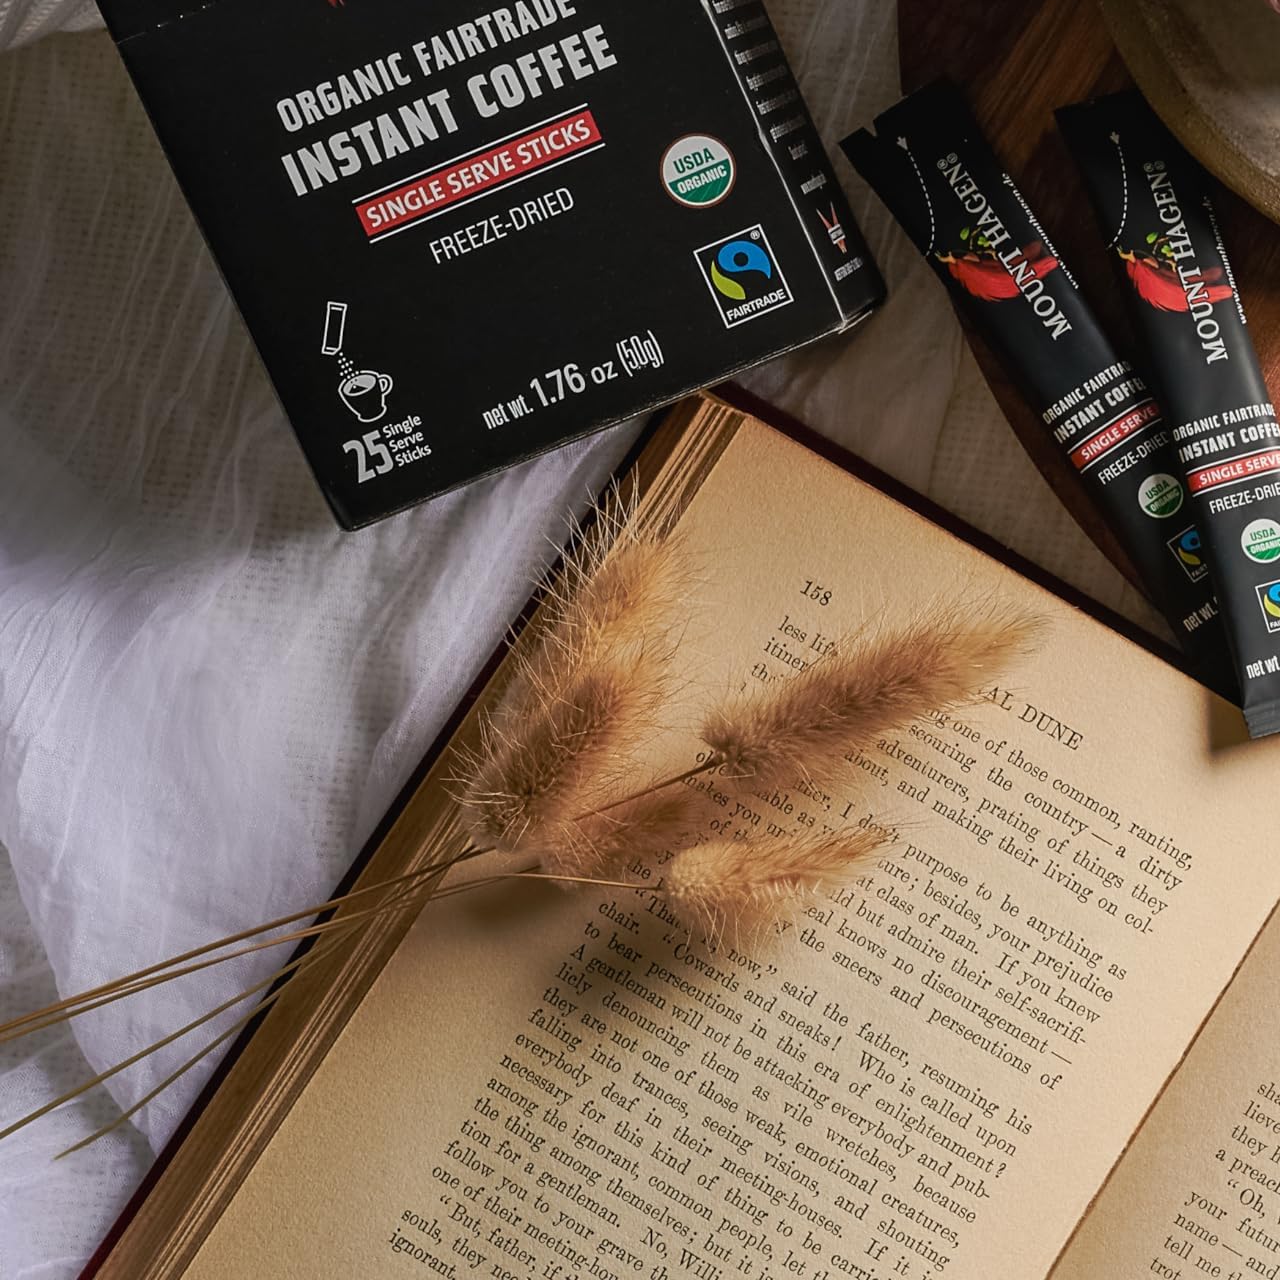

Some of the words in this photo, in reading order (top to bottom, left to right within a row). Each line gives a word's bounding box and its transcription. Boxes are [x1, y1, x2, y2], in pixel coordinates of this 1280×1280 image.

[276, 52, 412, 133] ORGANIC
[281, 88, 459, 197] INSTANT
[466, 24, 618, 118] COFFEE
[366, 180, 446, 228] SINGLE
[447, 151, 516, 194] SERVE
[520, 119, 591, 165] STICKS
[673, 147, 715, 174] USDA
[677, 165, 728, 195] ORGANIC
[429, 187, 575, 264] FREEZE-DRIED
[726, 288, 787, 321] FAIRTRADE
[998, 246, 1072, 341] MOUNT
[1177, 266, 1229, 365] MOUNT
[482, 402, 508, 430] net
[509, 394, 534, 419] wt.
[530, 363, 586, 407] 1.76
[590, 360, 618, 386] oz
[616, 329, 665, 377] (50g)
[1042, 387, 1085, 425] ORGANIC
[1084, 361, 1132, 395] FAIRTRAD
[382, 414, 422, 438] Single
[1053, 399, 1106, 444] INSTANT
[1081, 429, 1120, 460] SINGLE
[1120, 407, 1155, 434] SERVE
[1172, 414, 1220, 442] ORGANIC
[1179, 432, 1236, 464] INSTANT
[343, 430, 394, 484] 25
[389, 429, 424, 453] Serve
[395, 443, 432, 468] Sticks
[1098, 431, 1170, 485] FREEZE-DRIED
[1199, 464, 1243, 486] SINGLE
[1145, 479, 1170, 500] USDA
[1150, 485, 1181, 513] ORGANIC
[1250, 528, 1276, 541] USDA
[800, 580, 832, 606] 158
[1183, 613, 1203, 632] net
[1246, 660, 1265, 679] net
[1018, 703, 1084, 750] DUNE
[952, 720, 981, 743] one
[984, 739, 1008, 756] of
[1007, 749, 1049, 782] those
[1052, 779, 1121, 830] common,
[1127, 822, 1193, 871] ranting,
[896, 780, 931, 804] and
[931, 799, 994, 846] making
[998, 835, 1039, 868] their
[1042, 859, 1094, 904] living
[1097, 897, 1118, 917] on
[1124, 913, 1153, 934] col-
[876, 885, 915, 916] class
[918, 912, 941, 929] of
[939, 924, 979, 955] man.
[995, 951, 1020, 976] If
[1015, 971, 1052, 997] you
[1054, 986, 1101, 1023] knew
[584, 920, 601, 940] to
[607, 931, 643, 964] bear
[644, 961, 743, 1025] persecutions
[749, 1018, 767, 1041] in
[776, 1035, 807, 1063] this
[813, 1061, 840, 1084] era
[848, 1082, 872, 1100] of
[799, 928, 825, 953] the
[831, 951, 883, 987] sneers
[889, 985, 925, 1010] and
[925, 1007, 1032, 1074] persecutions
[1039, 1073, 1063, 1091] of
[554, 961, 593, 996] licly
[602, 991, 691, 1057] denouncing
[700, 1051, 740, 1084] them
[751, 1085, 771, 1102] as
[783, 1101, 813, 1127] vile
[826, 1127, 897, 1183] wretches,
[912, 1174, 976, 1223] because
[569, 943, 586, 962] A
[584, 957, 667, 1011] gentleman
[671, 1004, 704, 1031] will
[701, 1024, 731, 1048] not
[732, 1036, 752, 1060] be
[753, 1056, 831, 1110] attacking
[831, 1102, 916, 1159] everybody
[916, 1153, 953, 1179] and
[949, 1172, 990, 1199] pub-
[527, 1008, 583, 1053] falling
[589, 1043, 622, 1074] into
[632, 1071, 689, 1120] trances,
[701, 1115, 754, 1156] seeing
[764, 1151, 820, 1198] visions,
[833, 1195, 870, 1221] and
[876, 1218, 951, 1272] shouting
[1231, 1125, 1269, 1156] they
[486, 1077, 540, 1119] among
[542, 1108, 568, 1133] the
[571, 1124, 640, 1181] ignorant,
[648, 1175, 713, 1222] common
[715, 1217, 773, 1262] people,
[781, 1249, 807, 1276] let
[388, 1227, 457, 1280] ignorant.
